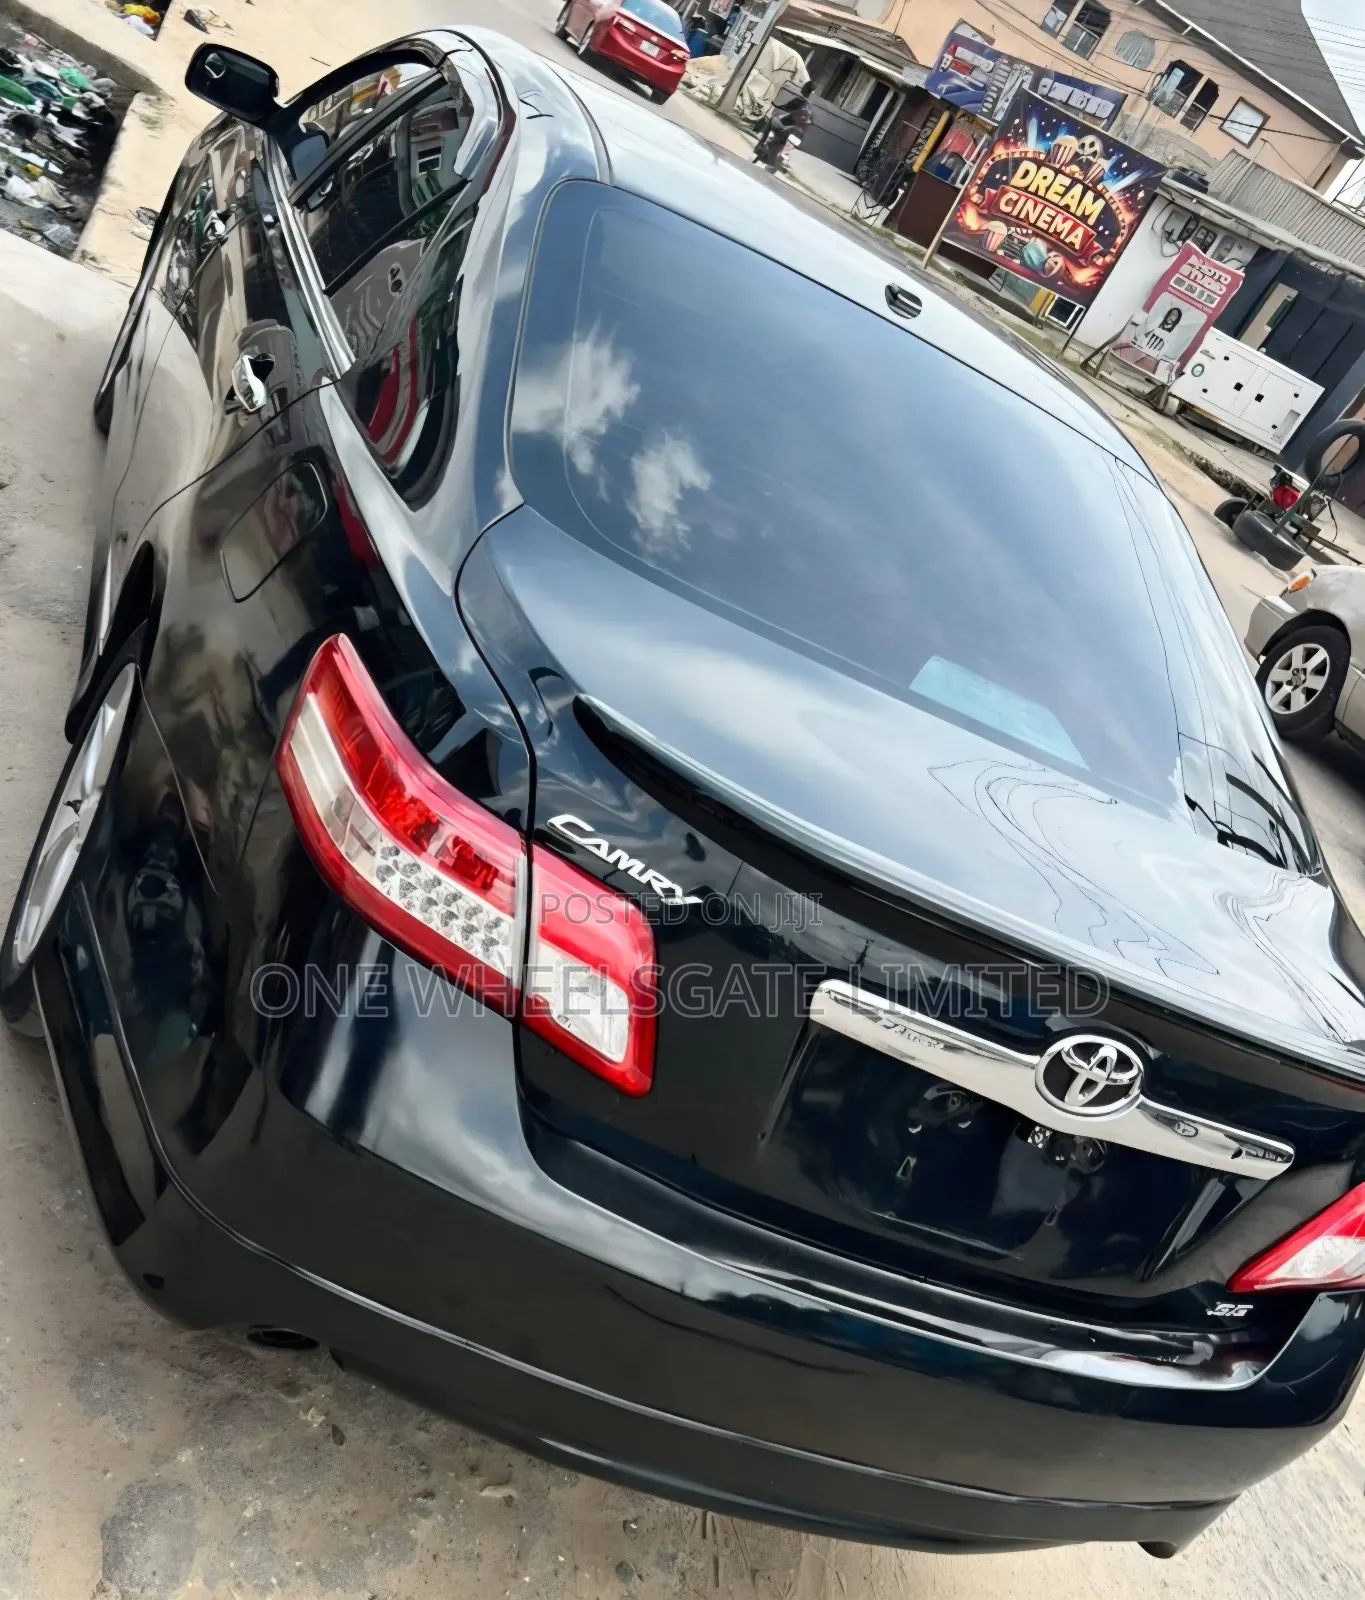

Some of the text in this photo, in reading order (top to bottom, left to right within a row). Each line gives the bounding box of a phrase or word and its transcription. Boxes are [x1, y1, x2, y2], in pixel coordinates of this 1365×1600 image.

[1000, 191, 1085, 250] CINEMA
[1010, 160, 1106, 226] DREAM
[547, 814, 703, 905] CAMRY
